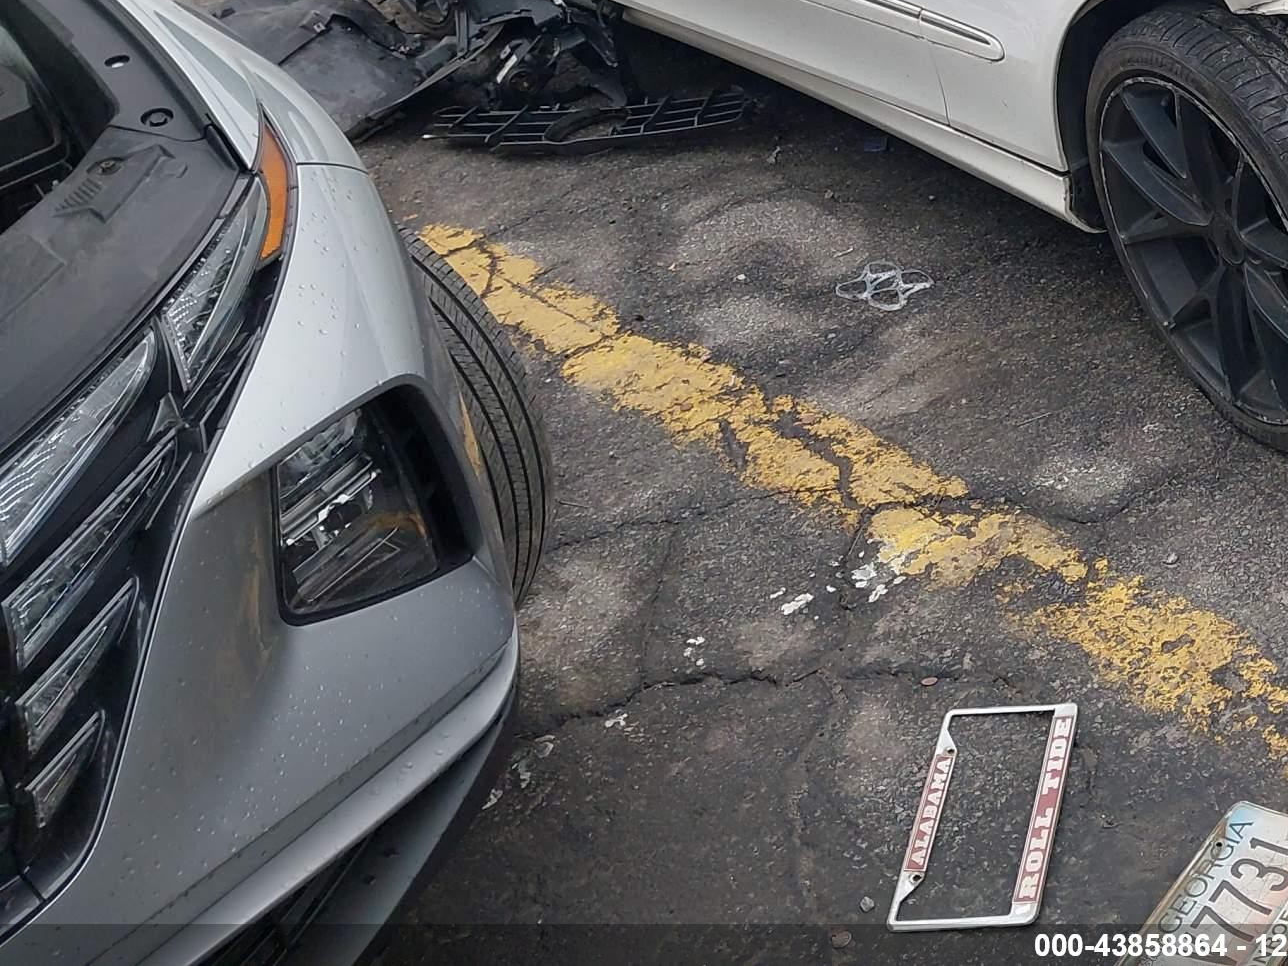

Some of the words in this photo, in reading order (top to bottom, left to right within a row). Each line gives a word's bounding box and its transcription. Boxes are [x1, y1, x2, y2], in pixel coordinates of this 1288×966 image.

[909, 757, 952, 866] ALABAMA
[1017, 807, 1054, 900] ROLL
[1039, 717, 1073, 796] TIDE
[1157, 820, 1254, 936] GEORGIA
